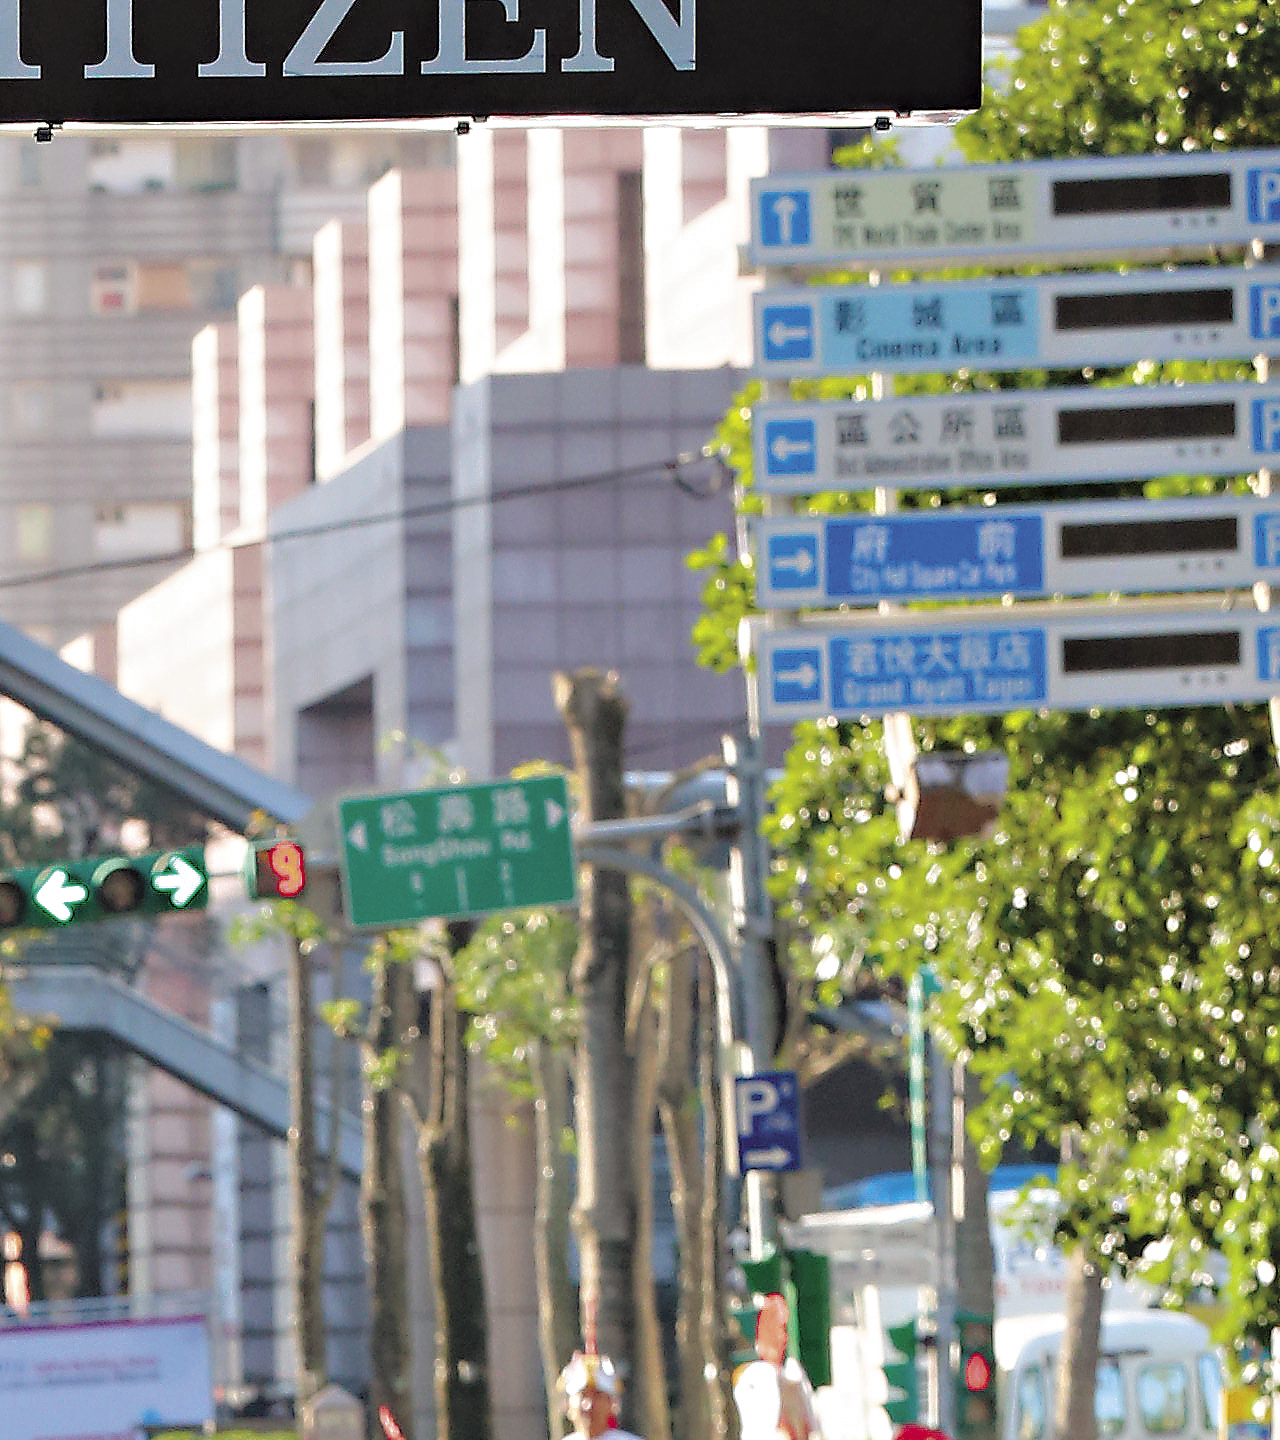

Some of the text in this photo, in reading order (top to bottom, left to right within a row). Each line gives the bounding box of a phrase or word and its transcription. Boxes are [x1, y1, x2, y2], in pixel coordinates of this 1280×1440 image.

[858, 334, 1001, 360] Cinema Area
[737, 1081, 780, 1135] P
